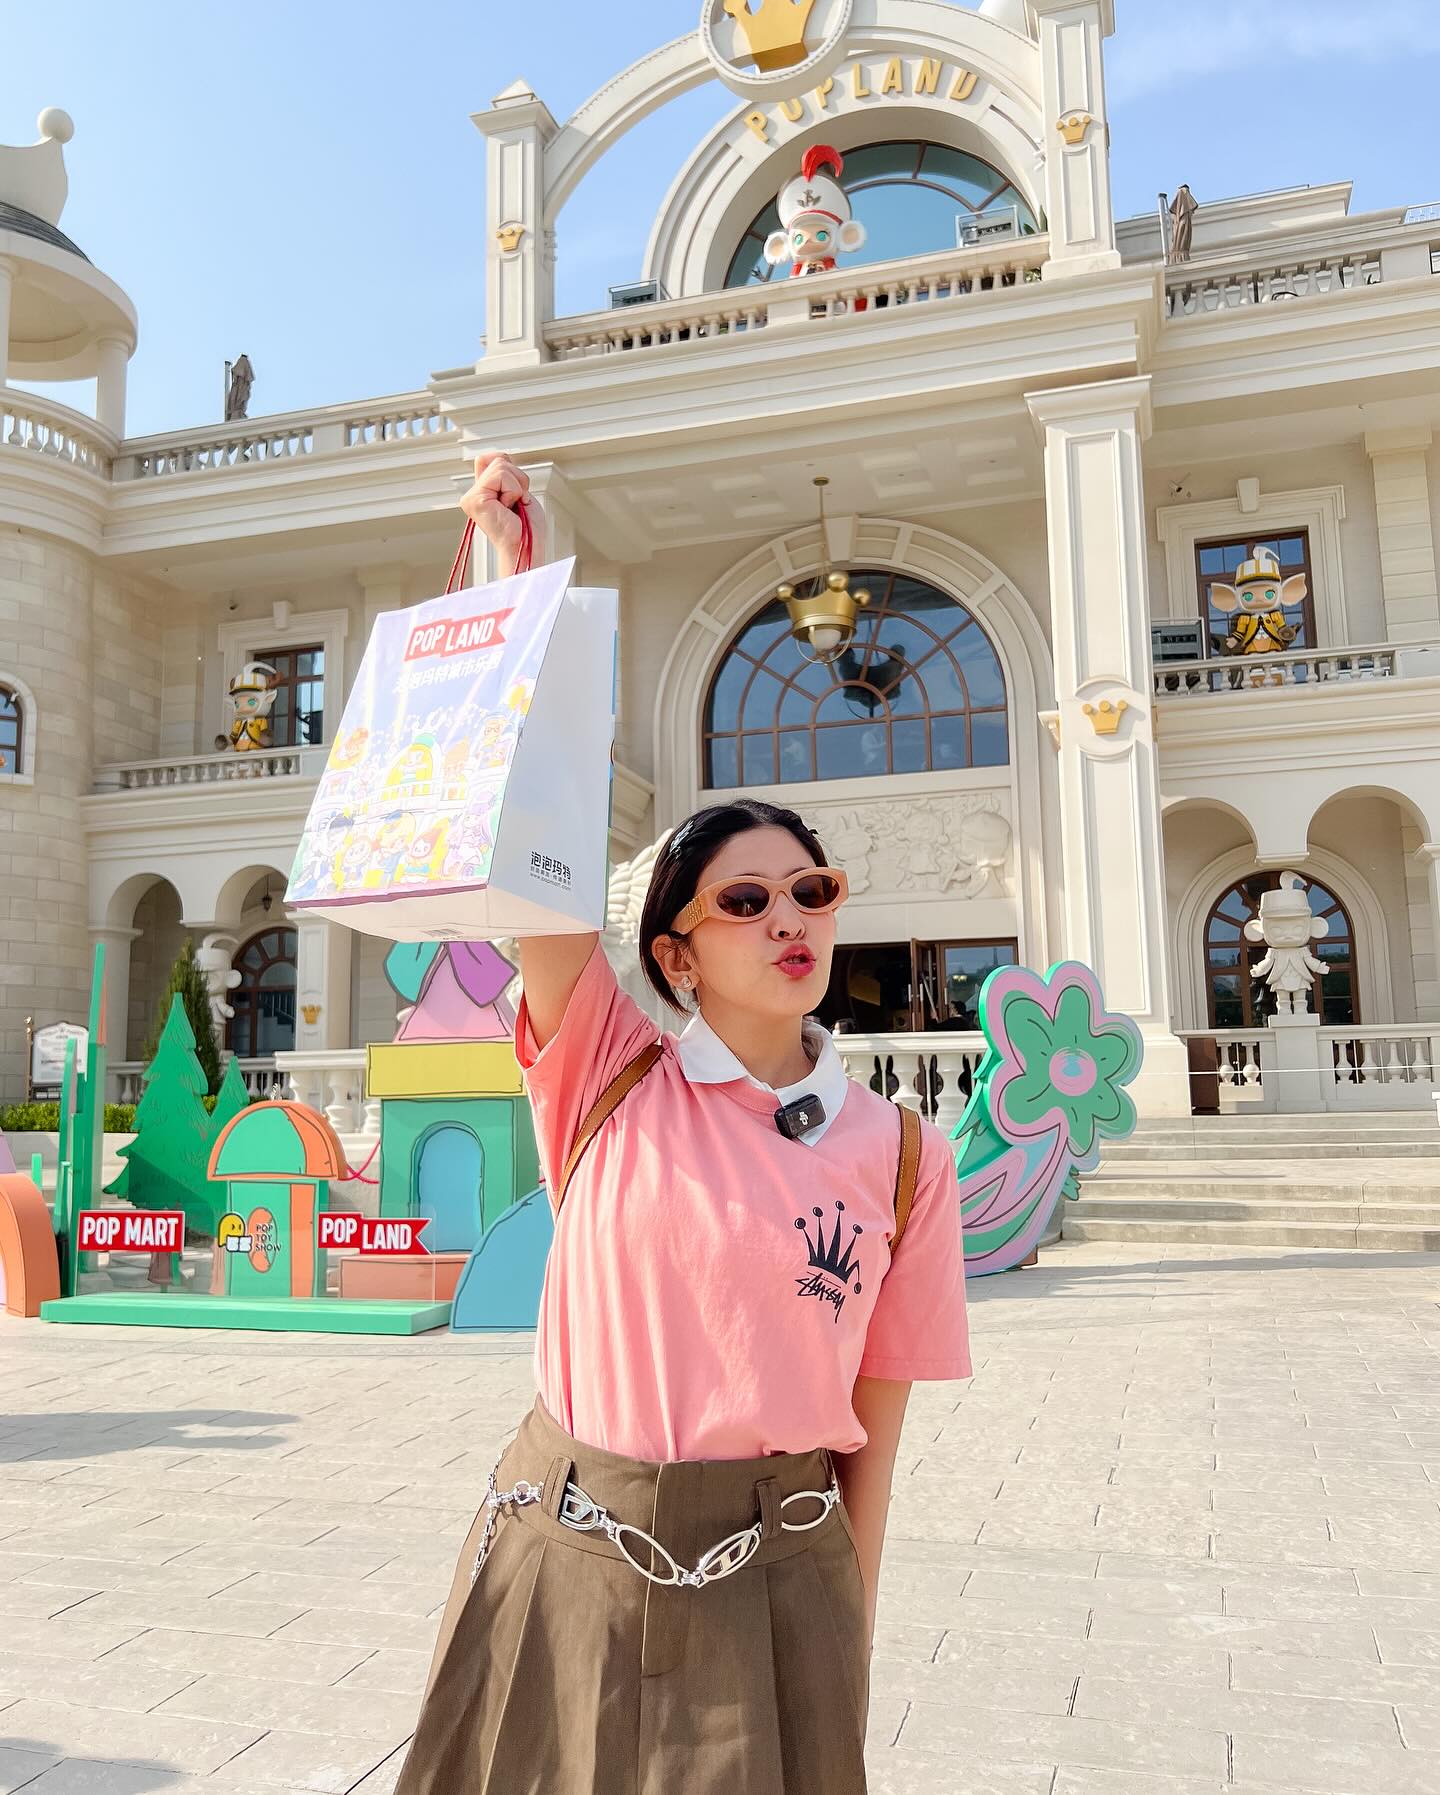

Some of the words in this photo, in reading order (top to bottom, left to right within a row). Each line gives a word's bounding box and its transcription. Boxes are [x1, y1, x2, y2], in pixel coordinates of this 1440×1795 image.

[409, 624, 446, 656] POP
[445, 618, 496, 652] LAND
[530, 850, 571, 880] 泡泡玛特
[82, 1216, 120, 1246] POP
[123, 1216, 179, 1246] MART
[256, 1224, 273, 1232] POP
[256, 1234, 272, 1242] TOY
[321, 1217, 357, 1244] POP
[362, 1223, 412, 1250] LAND
